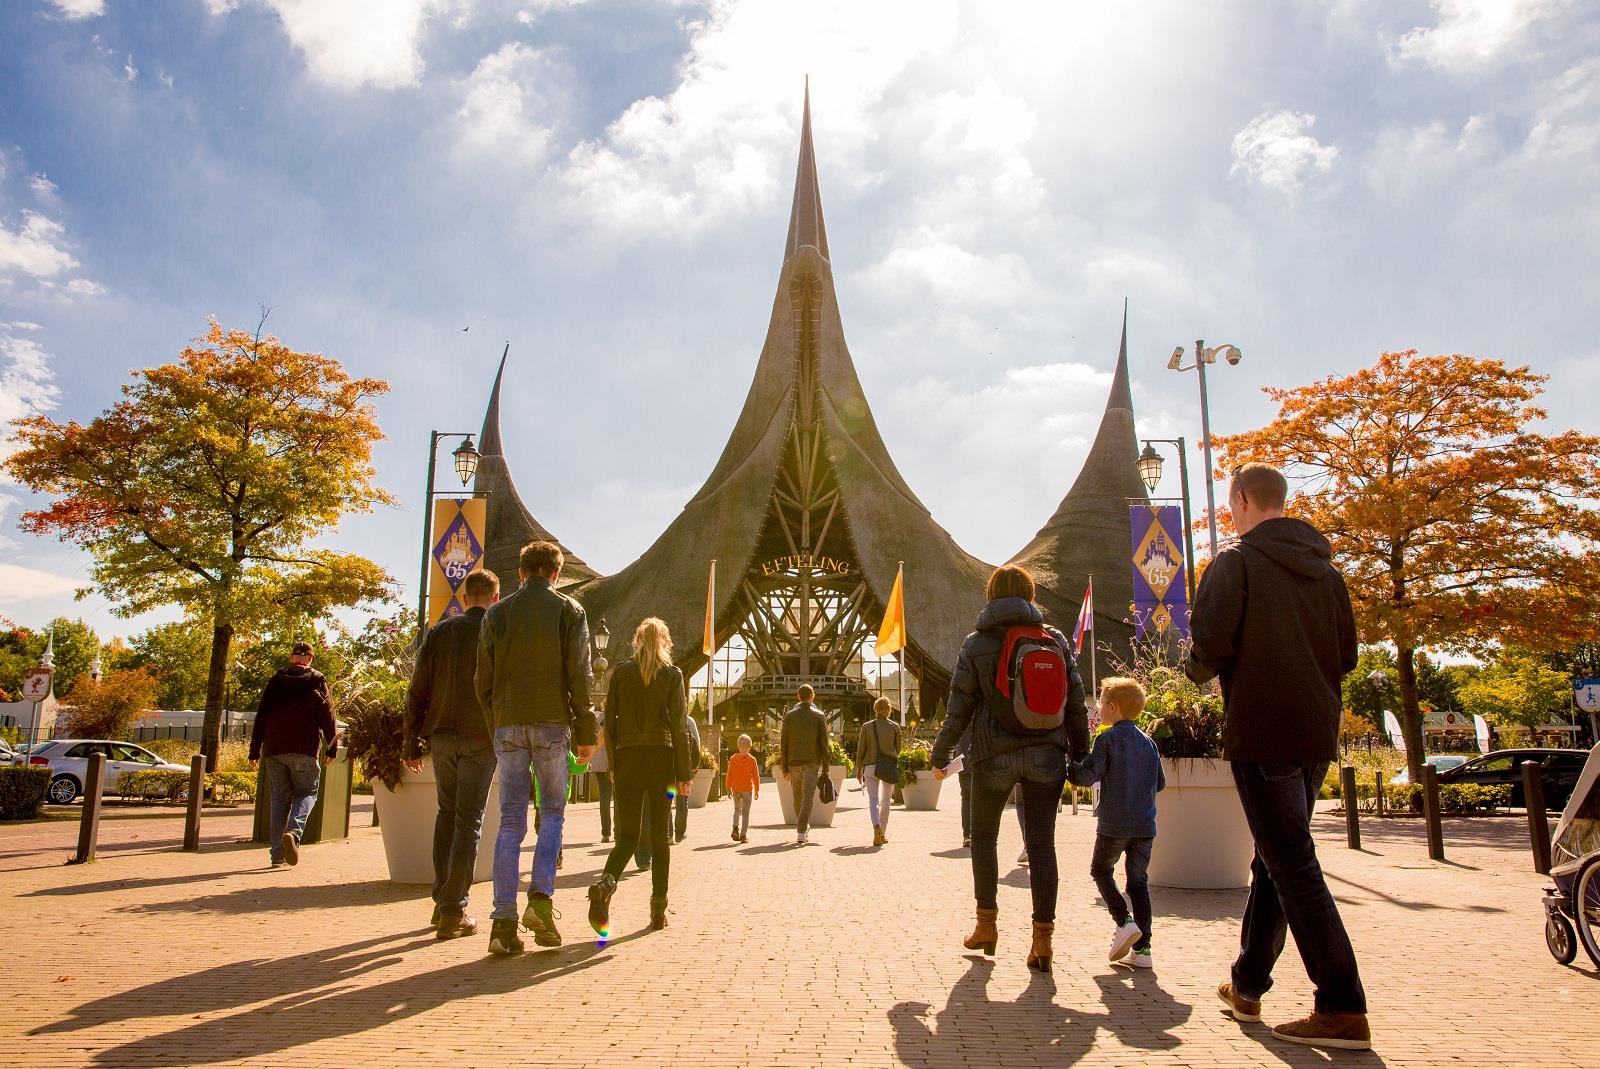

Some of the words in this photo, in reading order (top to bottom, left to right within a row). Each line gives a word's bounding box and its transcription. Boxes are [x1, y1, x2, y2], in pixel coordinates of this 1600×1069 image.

[445, 560, 467, 579] 65
[762, 555, 849, 576] EFTELING
[1148, 567, 1170, 586] 65
